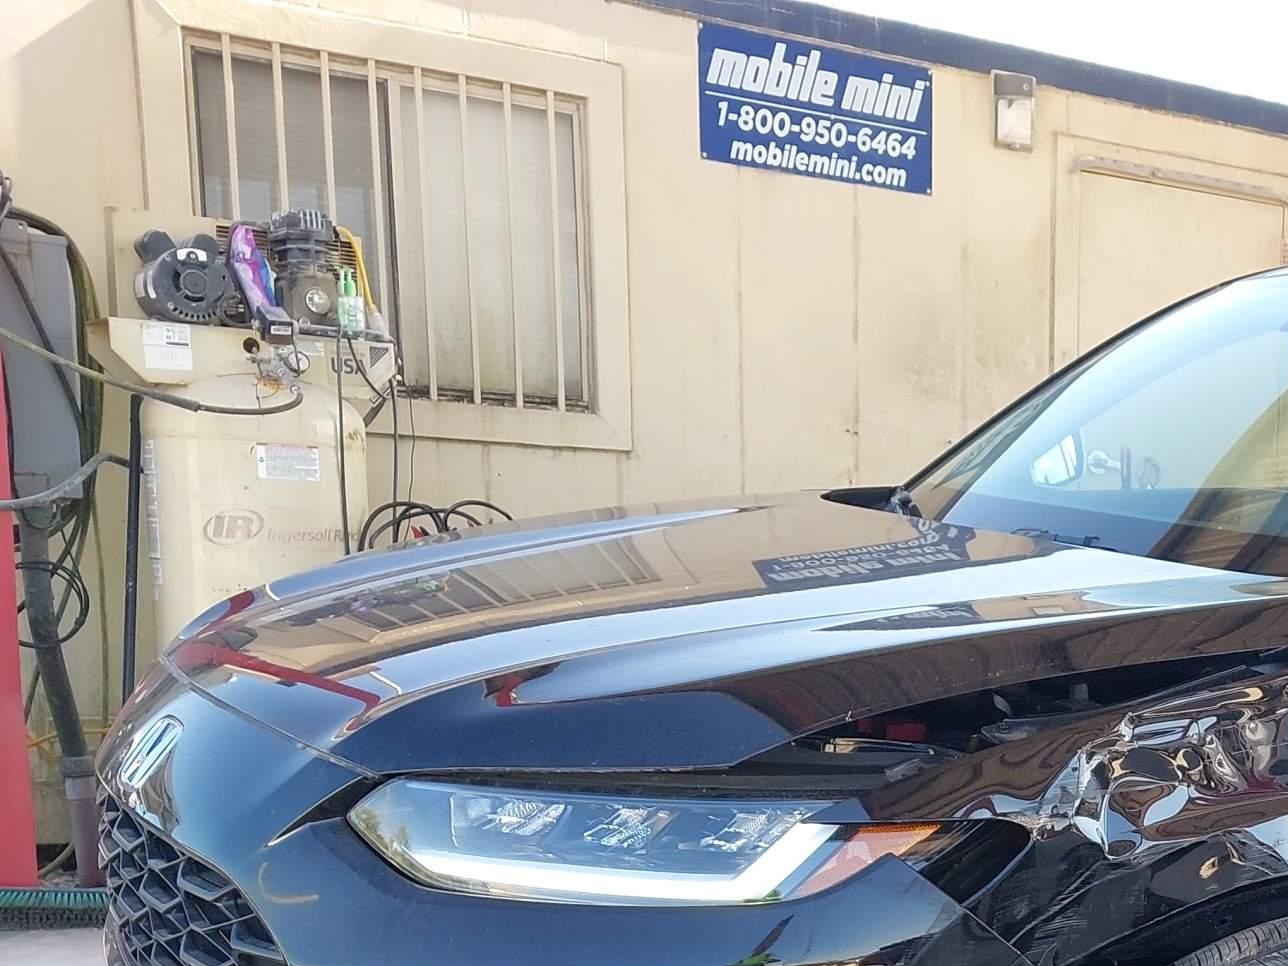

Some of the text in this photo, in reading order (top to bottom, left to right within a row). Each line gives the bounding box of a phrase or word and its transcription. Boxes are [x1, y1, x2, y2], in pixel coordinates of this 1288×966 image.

[706, 42, 926, 122] mobile mini
[717, 101, 917, 160] 1-800-950-6464
[730, 140, 908, 187] mobilemini.com
[331, 357, 367, 375] USA
